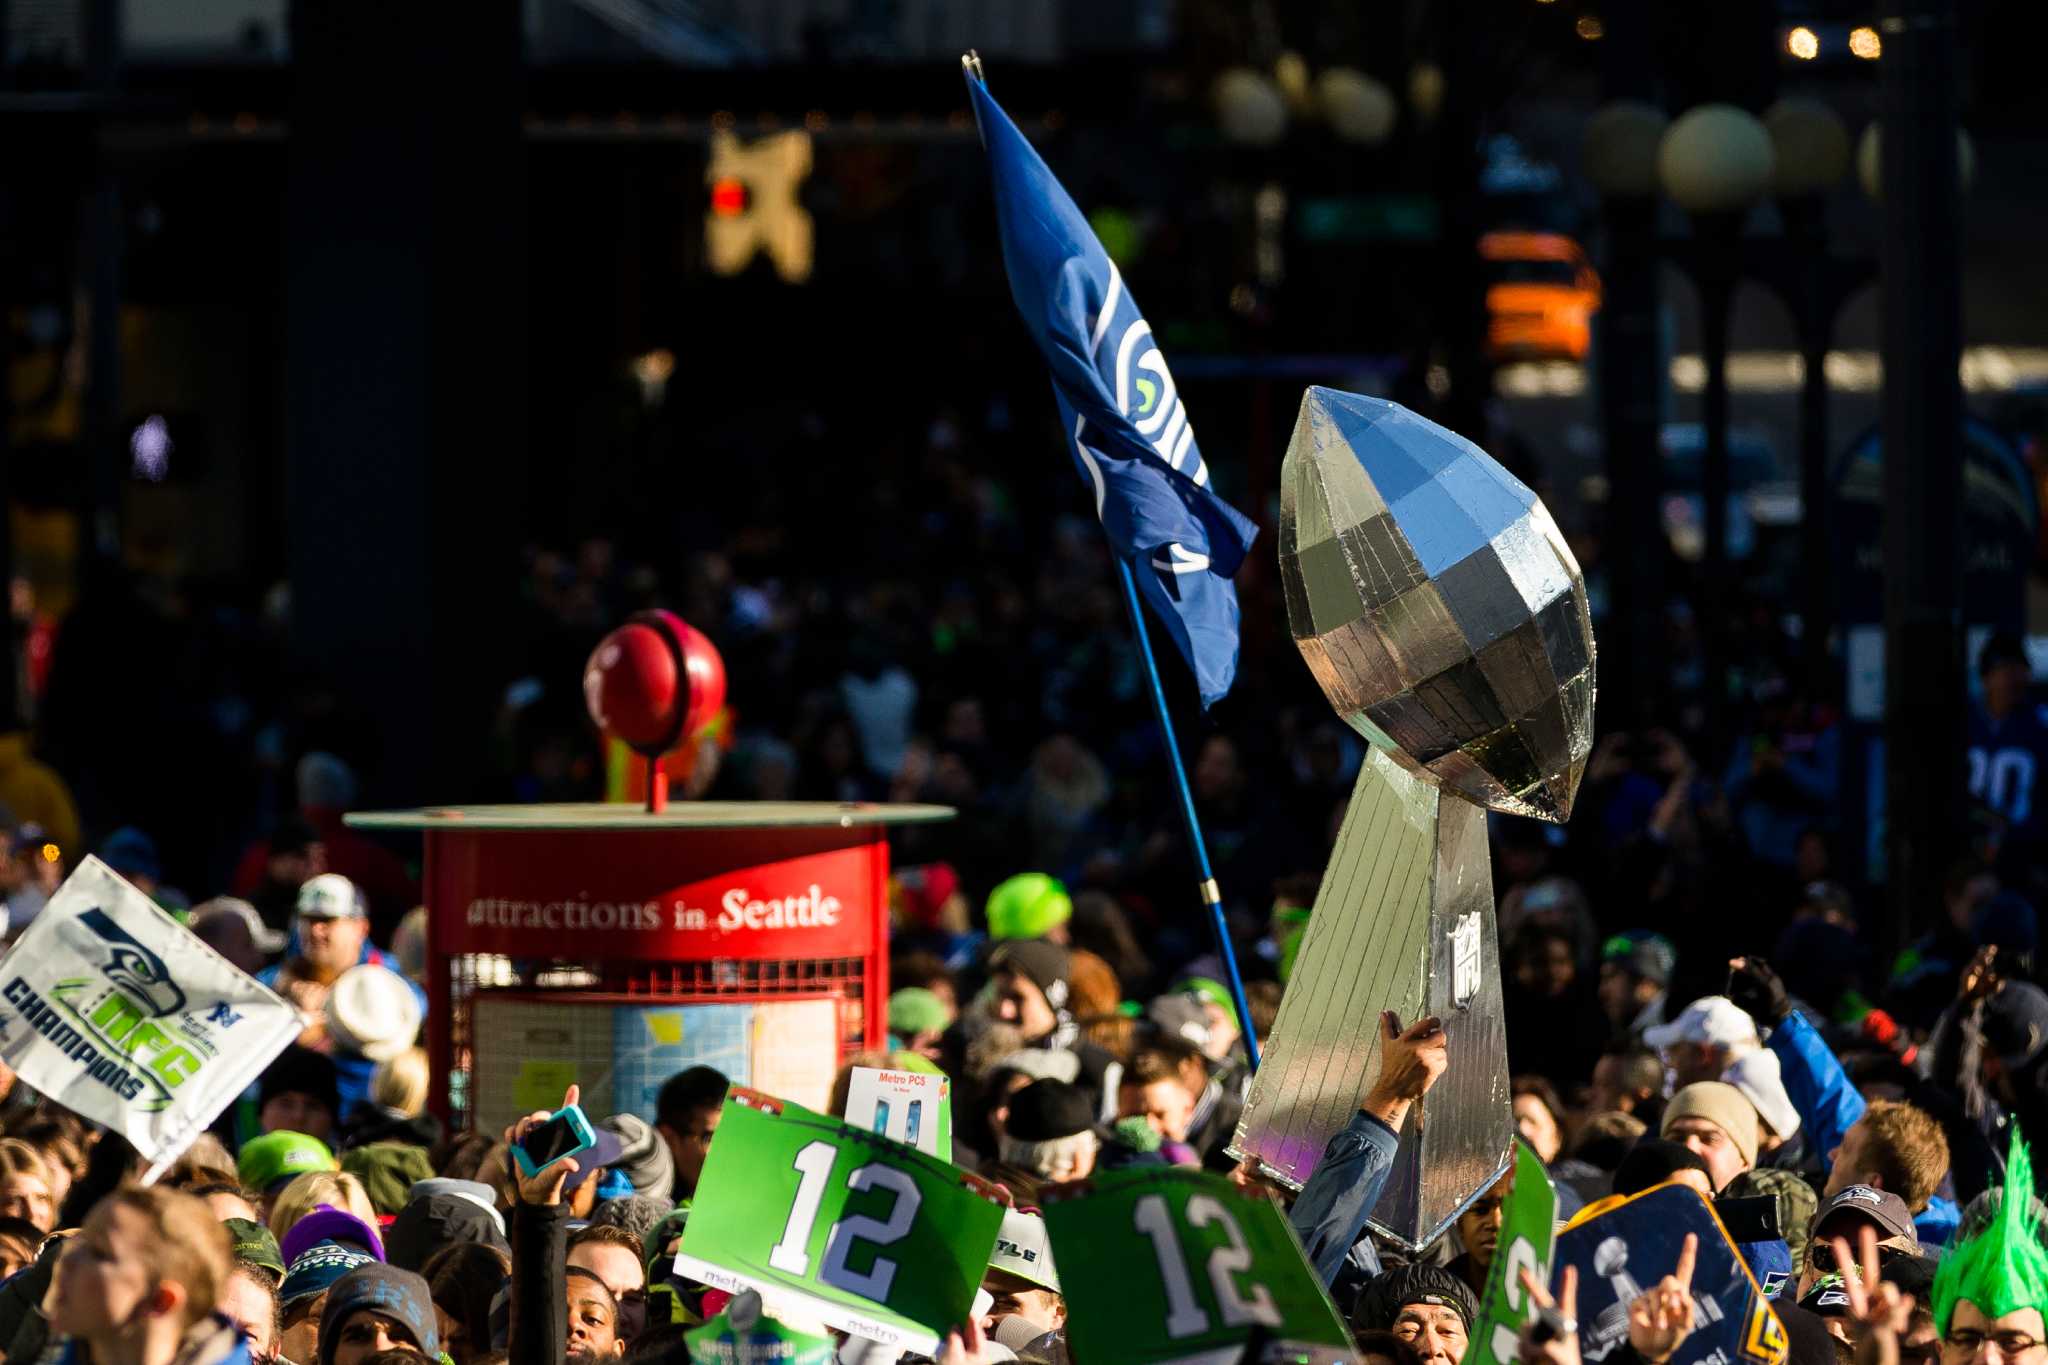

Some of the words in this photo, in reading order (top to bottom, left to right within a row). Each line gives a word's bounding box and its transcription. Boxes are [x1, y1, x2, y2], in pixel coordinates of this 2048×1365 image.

[466, 890, 661, 930] attractions
[674, 899, 706, 930] in
[719, 884, 841, 930] Seattle
[2, 976, 145, 1100] CHAMPIONS
[879, 1072, 905, 1084] Metro
[908, 1075, 925, 1086] PCS
[768, 1139, 922, 1304] 12
[1134, 1195, 1283, 1338] 12
